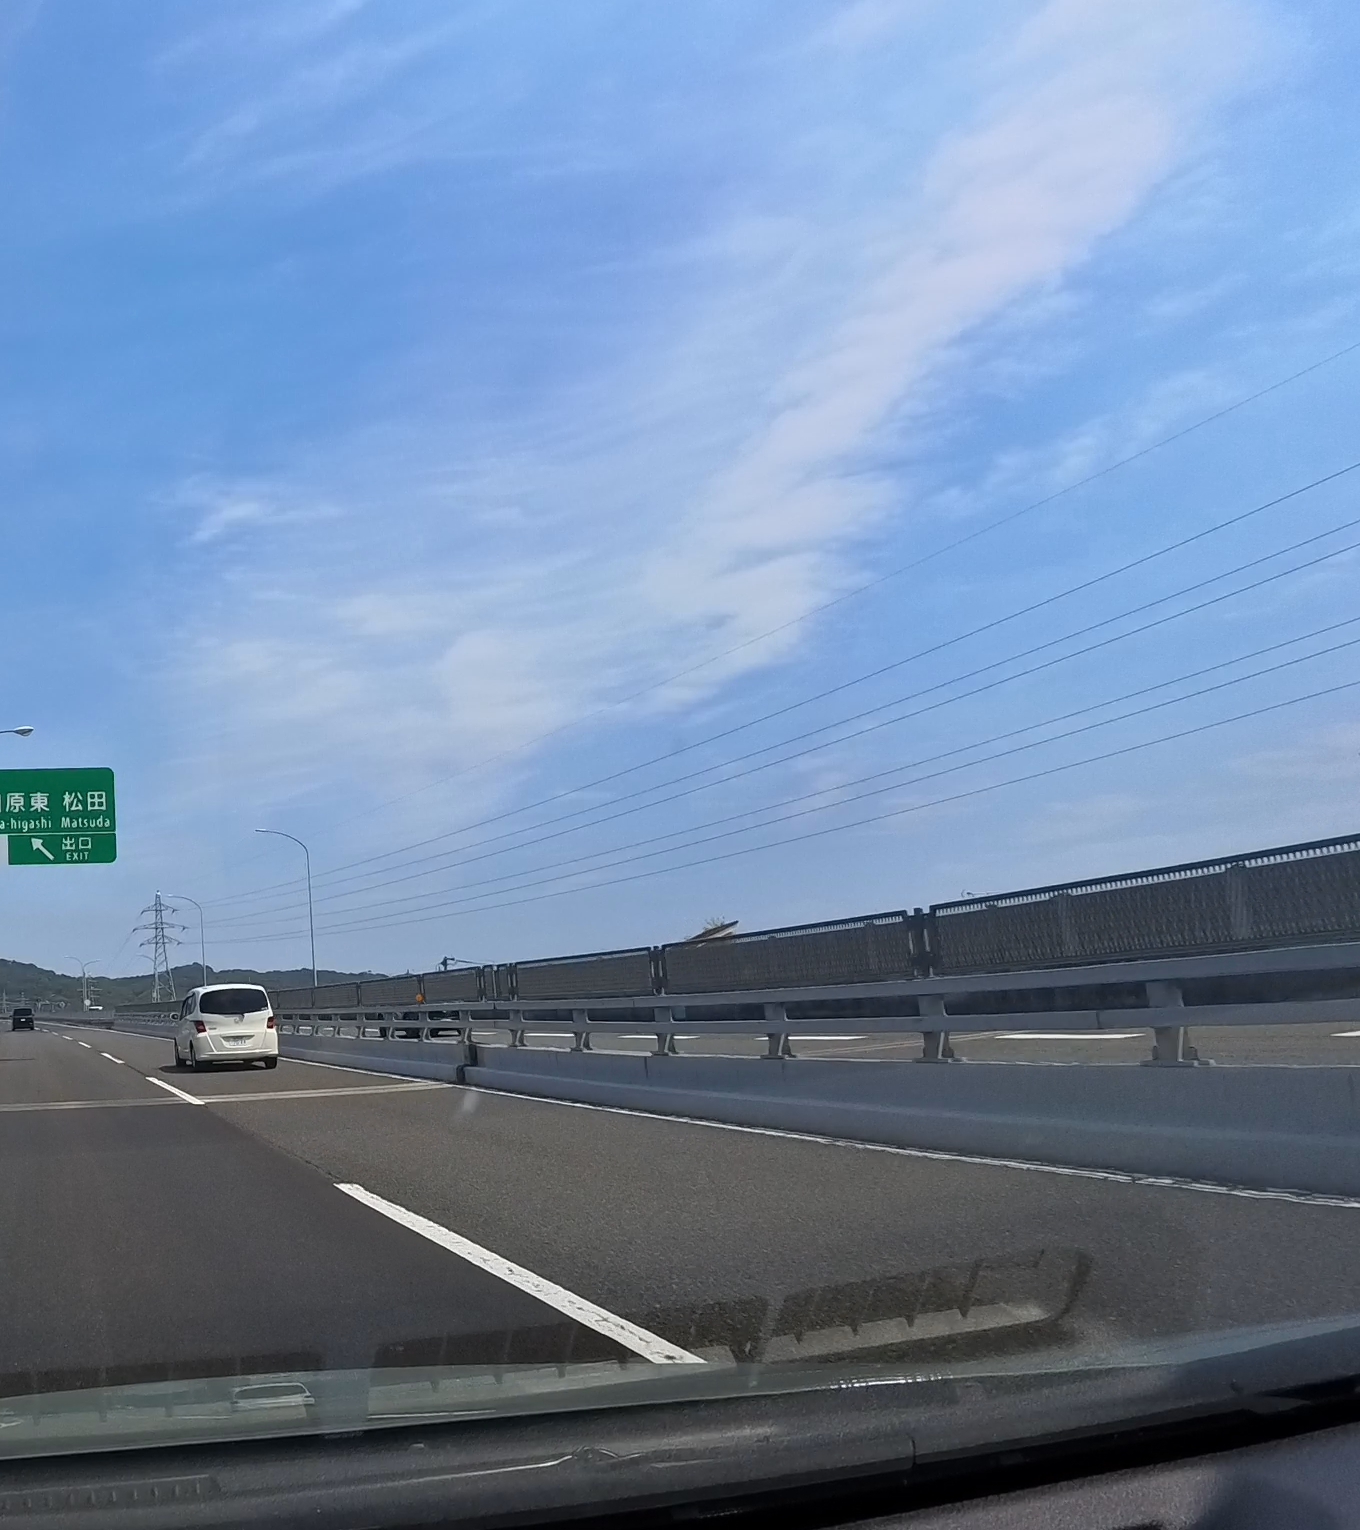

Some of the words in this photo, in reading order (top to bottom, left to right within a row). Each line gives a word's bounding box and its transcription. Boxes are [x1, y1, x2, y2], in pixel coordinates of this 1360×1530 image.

[62, 791, 107, 812] 松田
[61, 815, 110, 828] Matsuda
[62, 837, 92, 850] 出口
[66, 851, 89, 861] EXIT
